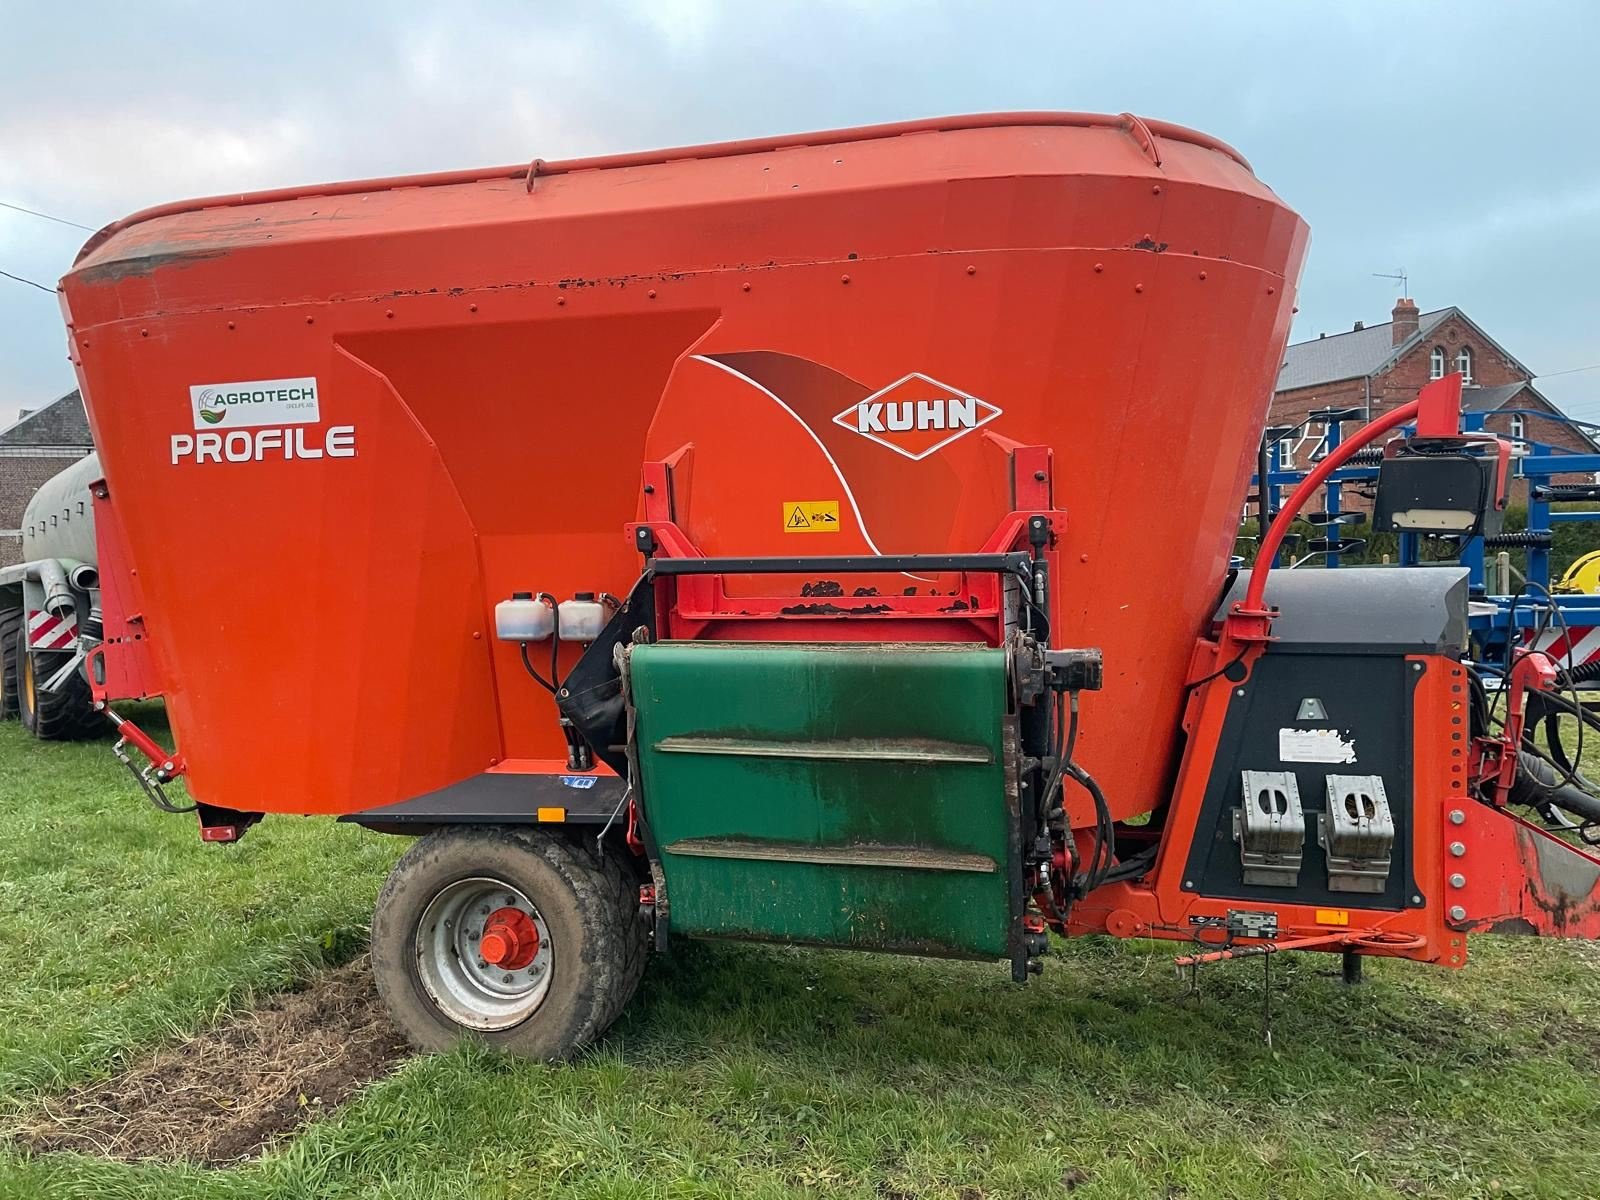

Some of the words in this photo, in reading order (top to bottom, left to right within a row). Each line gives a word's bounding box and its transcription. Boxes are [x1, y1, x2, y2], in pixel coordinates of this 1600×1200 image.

[213, 387, 315, 406] AGROTECH
[857, 398, 977, 433] KUHN
[170, 425, 356, 465] PROFILE
